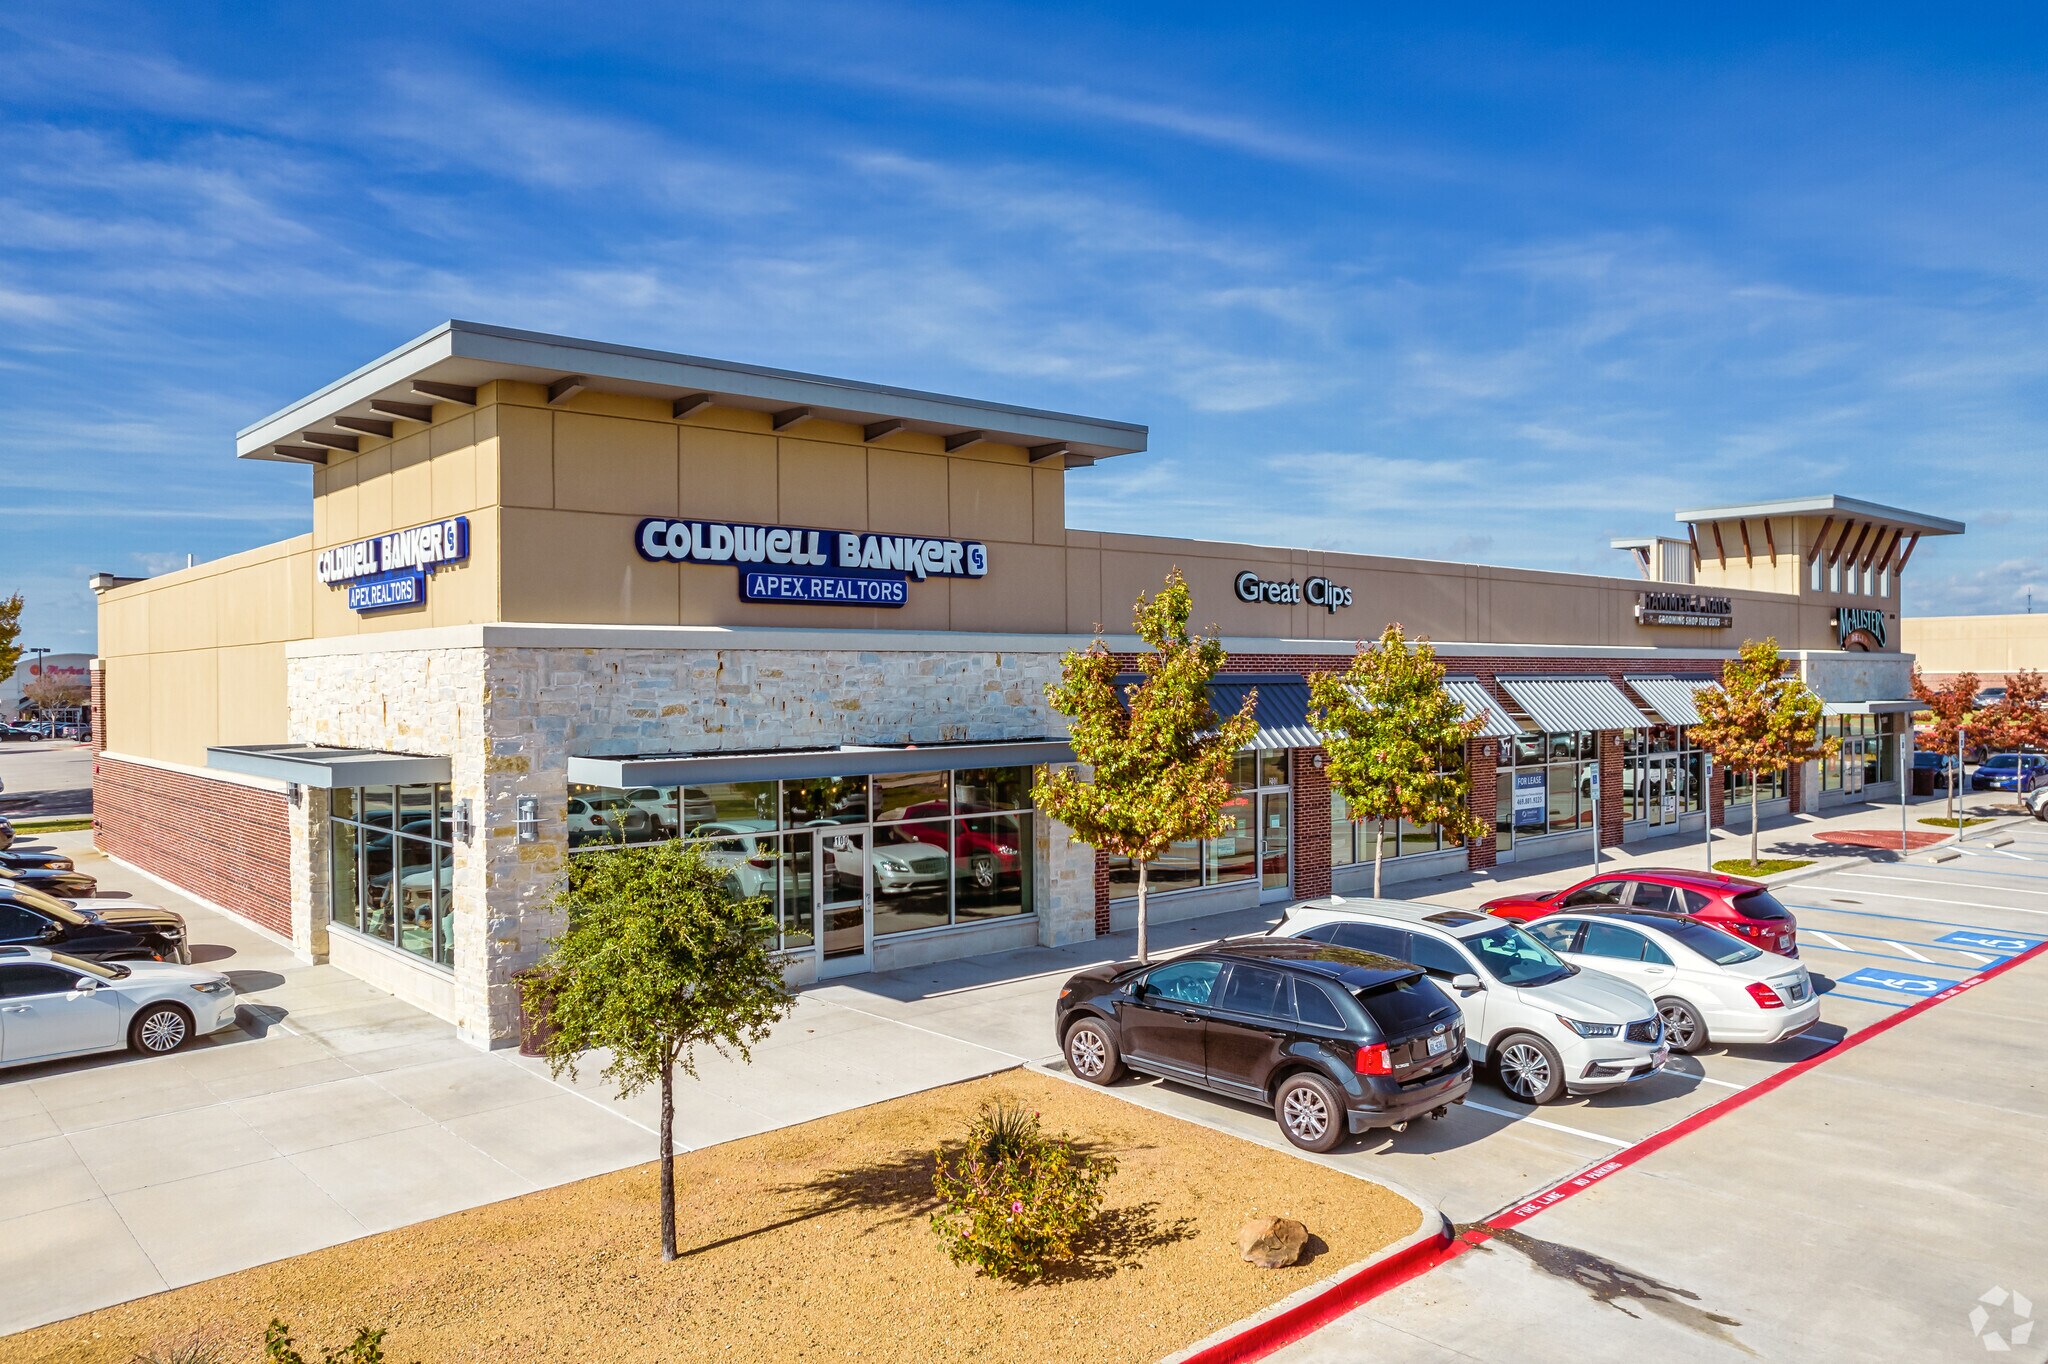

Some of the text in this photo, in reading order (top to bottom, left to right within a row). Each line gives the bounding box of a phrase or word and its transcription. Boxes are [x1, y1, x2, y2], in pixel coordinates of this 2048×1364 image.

[317, 540, 378, 583] COLDWELL
[381, 524, 443, 571] BANKER
[642, 521, 827, 566] COLDWELL
[838, 533, 965, 578] BANKER
[810, 579, 903, 601] REALTORS
[1238, 572, 1353, 612] Great Clips
[1645, 593, 1691, 612] HAMMER
[1705, 597, 1732, 614] NAILS
[1658, 615, 1685, 625] GROOMING
[1685, 617, 1698, 626] SHOP
[1698, 617, 1708, 626] FOR
[1517, 776, 1542, 786] FOR LEASE
[1514, 1161, 1623, 1217] FIRE LANE NO PARKING
